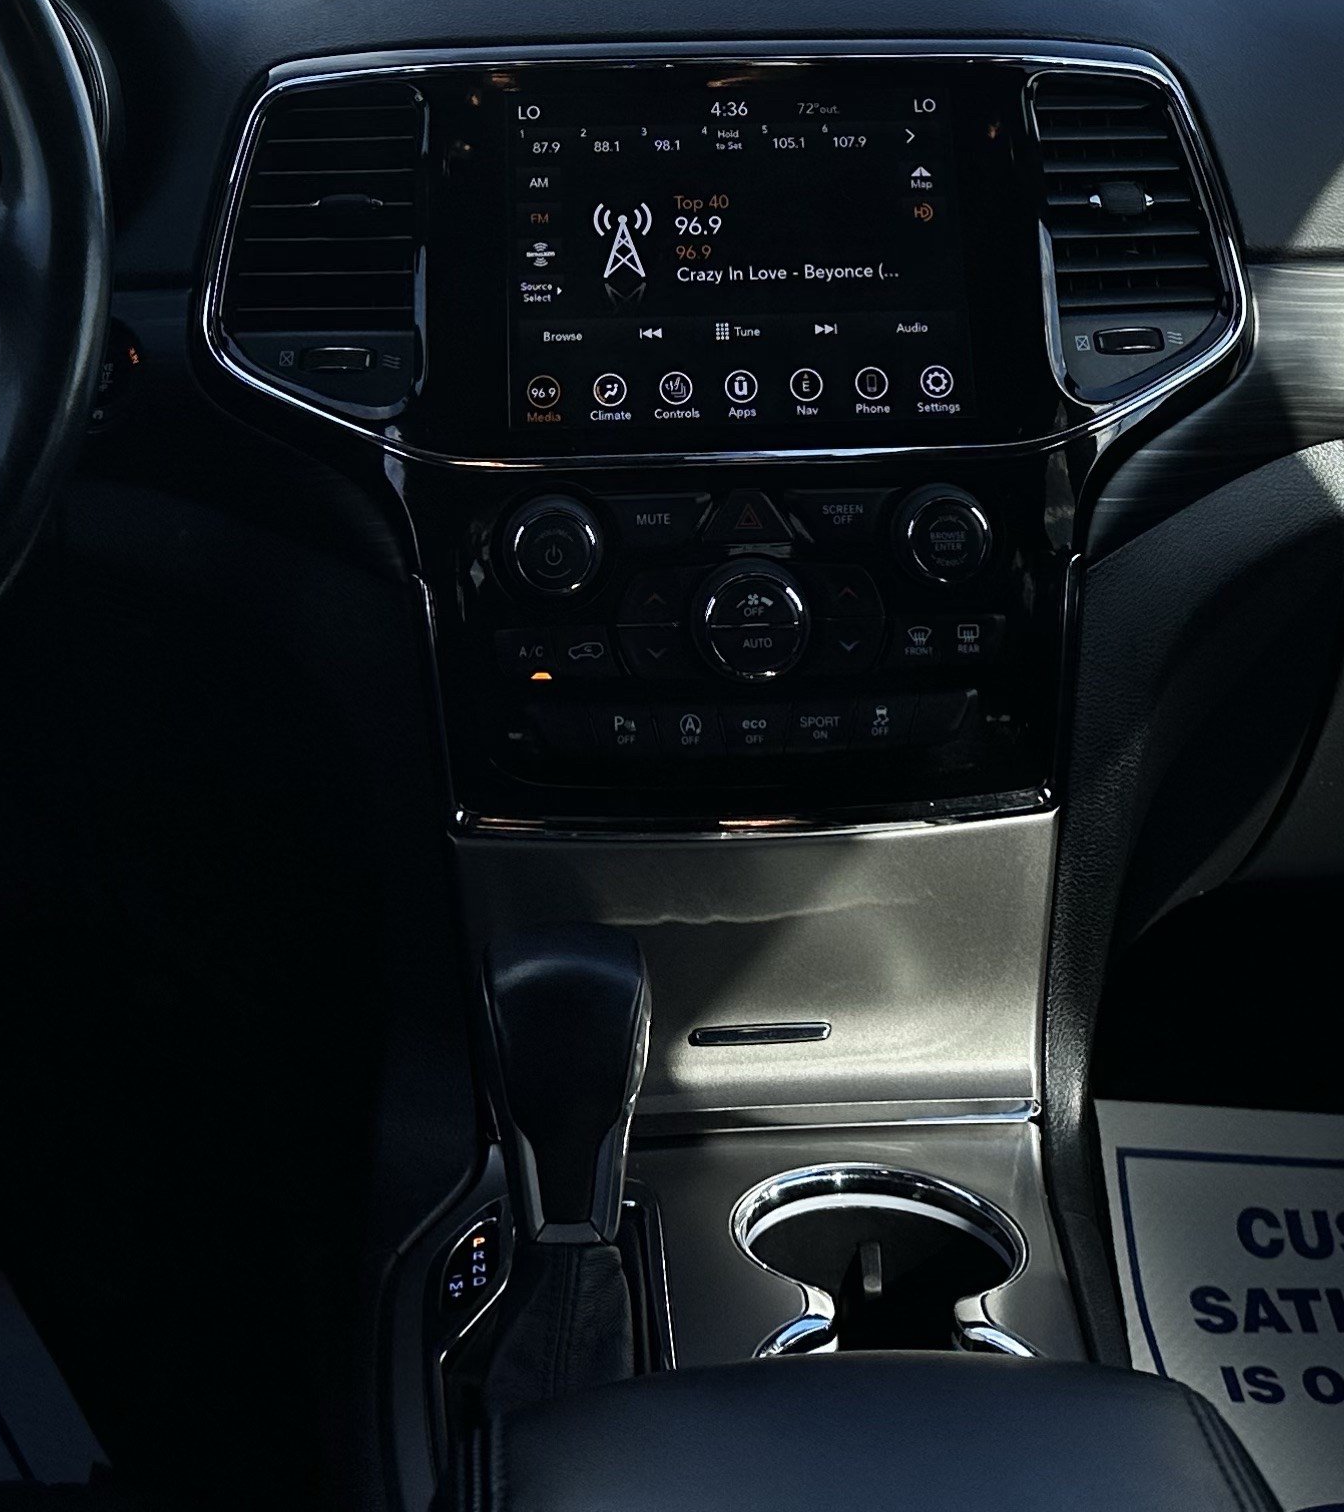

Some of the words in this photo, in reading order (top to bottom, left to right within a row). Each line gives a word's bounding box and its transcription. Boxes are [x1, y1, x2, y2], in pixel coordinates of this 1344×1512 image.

[710, 101, 748, 117] 4:36
[913, 98, 936, 113] LO
[518, 105, 541, 120] LO
[717, 129, 740, 140] Hold
[532, 141, 561, 155] 87.9
[594, 140, 621, 153] 88.1
[654, 139, 681, 152] 98.1
[715, 141, 726, 151] to
[727, 141, 743, 151] Set
[772, 136, 806, 150] 105.1
[832, 135, 868, 149] 107.9
[529, 177, 550, 189] AM
[910, 179, 934, 191] Map
[674, 195, 704, 214] Top
[709, 194, 730, 209] 40
[530, 213, 550, 225] FM
[674, 216, 723, 236] 96.9
[676, 244, 713, 261] 96.9
[677, 266, 723, 285] Crazy
[729, 266, 744, 281] In
[749, 264, 788, 281] Love
[804, 263, 874, 283] Beyonce
[520, 282, 553, 293] Source
[523, 294, 552, 304] Select
[734, 326, 761, 338] Tune
[896, 321, 929, 334] Audio
[543, 330, 583, 343] Browse
[654, 406, 701, 420] Controls
[728, 406, 758, 420] Apps
[796, 404, 819, 416] Nav
[855, 402, 891, 415] Phone
[917, 400, 962, 414] Settings
[527, 412, 562, 424] Media
[590, 409, 632, 422] Climate
[822, 504, 865, 516] SCREEN
[636, 513, 671, 527] MUTE
[832, 515, 854, 526] OFF
[934, 542, 963, 552] ENTER
[743, 606, 765, 619] OFF
[742, 636, 773, 649] AUTO
[518, 644, 544, 658] A/C
[904, 645, 934, 657] FRONT
[742, 718, 768, 730] eco
[799, 715, 841, 730] SPORT
[812, 729, 829, 741] ON
[870, 726, 890, 738] OFF
[616, 733, 636, 745] OFF
[681, 734, 701, 746] OFF
[744, 733, 765, 745] OFF
[472, 1236, 486, 1248] P
[472, 1249, 485, 1261] R
[472, 1262, 486, 1275] N
[449, 1279, 464, 1292] M
[472, 1275, 487, 1288] D
[1221, 1365, 1286, 1405] IS
